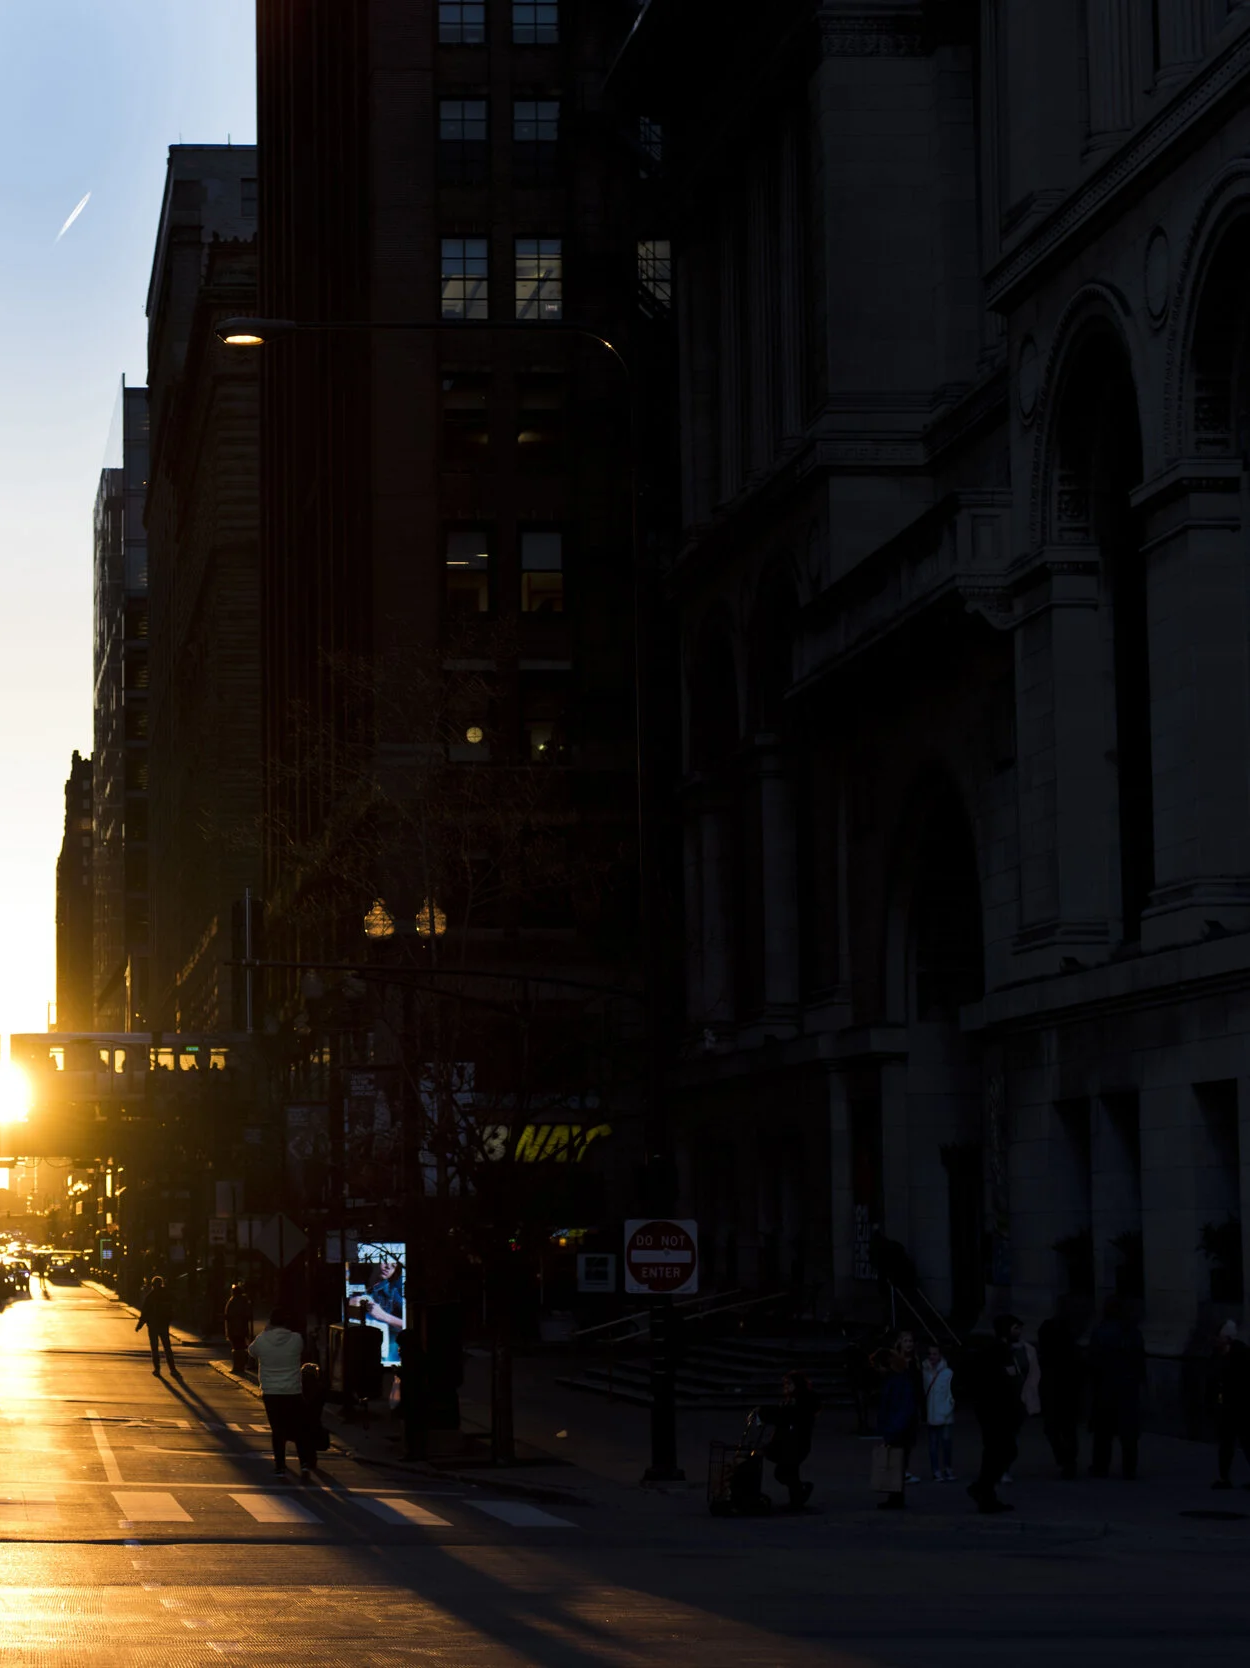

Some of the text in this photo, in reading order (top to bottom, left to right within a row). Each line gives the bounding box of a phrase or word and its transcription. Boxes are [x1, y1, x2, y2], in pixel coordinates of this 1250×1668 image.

[636, 1235, 685, 1247] DO NOT
[641, 1266, 680, 1279] ENTER
